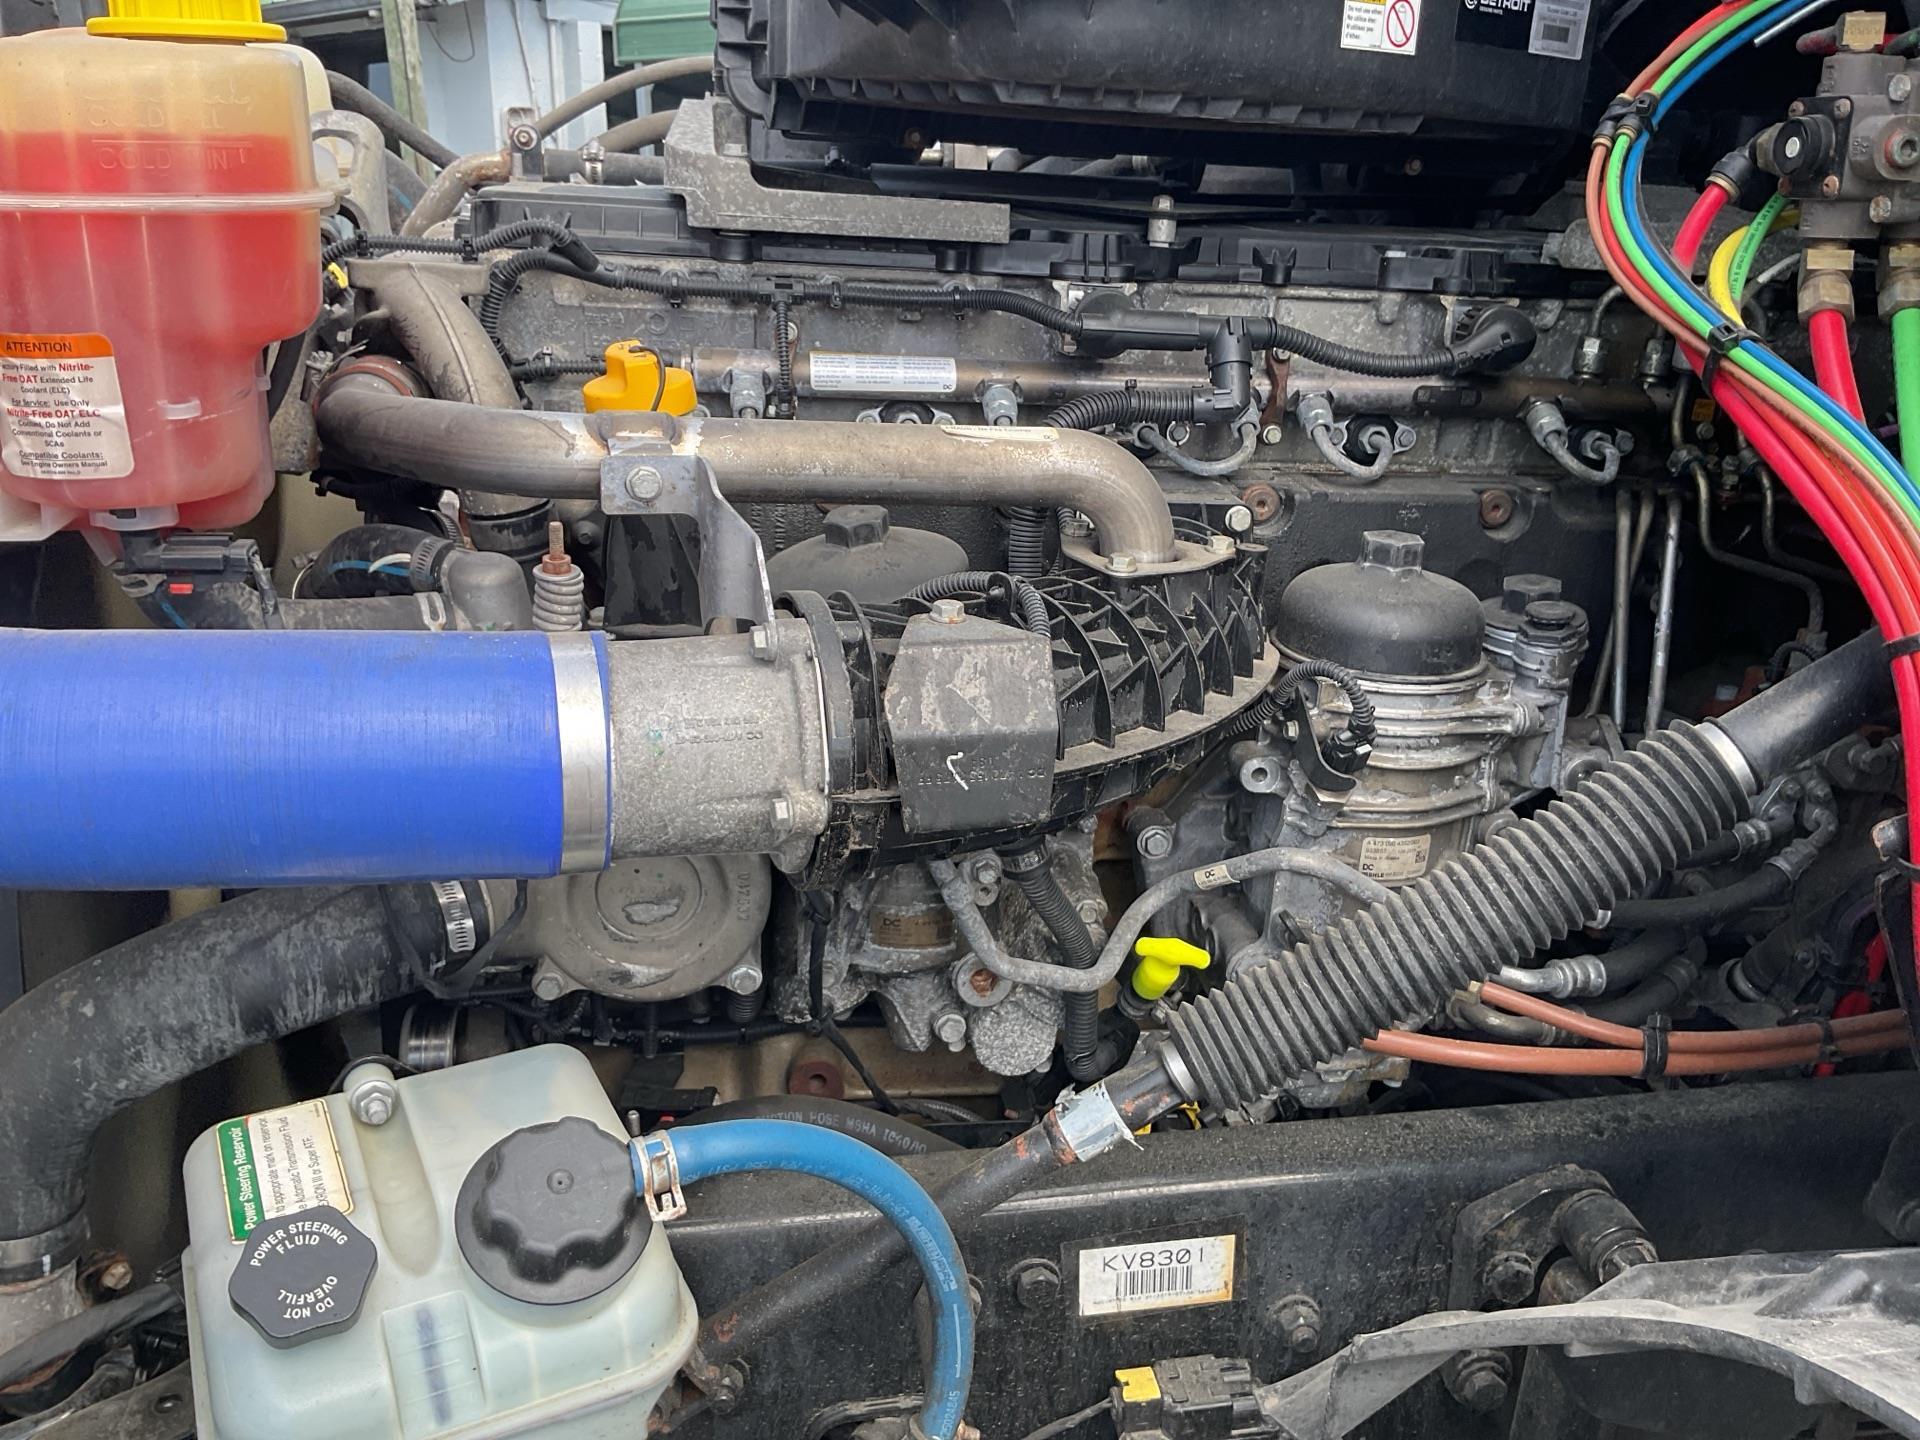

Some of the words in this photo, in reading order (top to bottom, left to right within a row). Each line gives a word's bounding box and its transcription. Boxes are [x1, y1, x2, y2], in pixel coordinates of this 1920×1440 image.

[6, 342, 72, 353] ATTENTION
[40, 376, 76, 384] Extended
[21, 386, 48, 394] Coolant
[78, 409, 101, 418] ELC
[55, 430, 91, 438] Coolants
[1204, 869, 1215, 879] DC
[1362, 863, 1374, 871] DC
[810, 1112, 840, 1126] HOSE
[845, 1117, 876, 1136] MSHA
[229, 1127, 248, 1165] Reservoir
[264, 1144, 274, 1152] on
[283, 1133, 300, 1173] Transmission
[264, 1153, 276, 1168] mark
[308, 1150, 320, 1168] Super
[236, 1164, 254, 1202] Steering
[269, 1168, 285, 1204] appropriate
[290, 1172, 304, 1204] Automatic
[312, 1183, 330, 1207] EXRON
[244, 1202, 256, 1230] Power
[275, 1205, 286, 1213] to
[250, 1229, 287, 1267] POWER
[288, 1221, 348, 1245] STEERING
[276, 1234, 320, 1254] FLUID
[1103, 1246, 1203, 1273] KV8301
[277, 1275, 338, 1305] OVERFILL
[283, 1307, 311, 1319] NOT
[315, 1297, 335, 1313] DO
